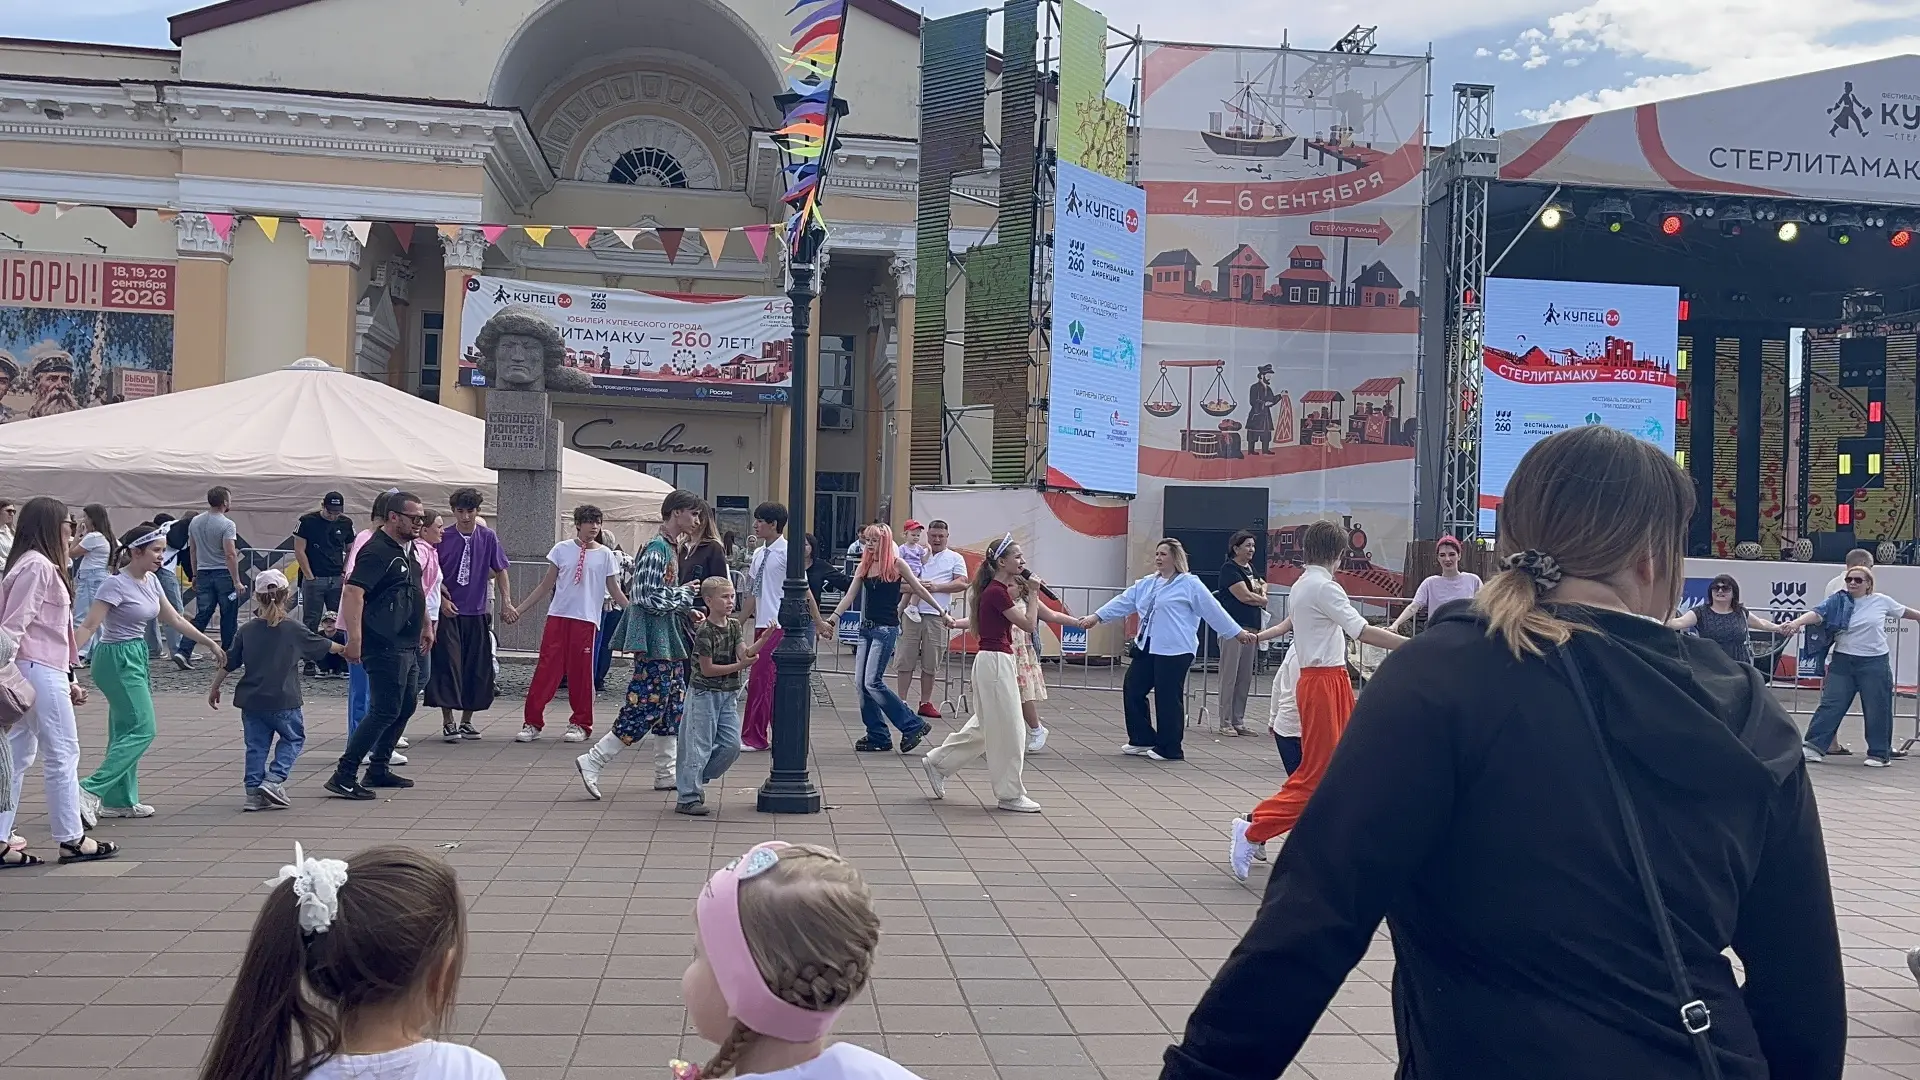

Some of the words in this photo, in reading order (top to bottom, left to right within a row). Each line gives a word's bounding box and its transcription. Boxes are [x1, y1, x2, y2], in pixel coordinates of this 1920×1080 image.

[1183, 188, 1199, 208] 4
[1238, 190, 1253, 211] 6
[1261, 171, 1385, 210] СЕНТЯБРЯ
[1086, 199, 1124, 227] КУПЕЦ
[1126, 215, 1138, 226] 2.0
[1314, 224, 1379, 234] СТЕРЛИТАМАК
[1068, 256, 1084, 272] 260
[1092, 259, 1134, 276] ФЕСТИВАЛЬНАЯ
[112, 266, 129, 279] 18,
[131, 267, 147, 279] 19,
[150, 268, 167, 279] 20
[1091, 270, 1120, 282] ДИРЕКЦИЯ
[112, 280, 167, 290] сентября
[111, 289, 167, 306] 2026
[514, 292, 556, 306] КУПЕЦ
[591, 302, 607, 310] 260
[567, 315, 604, 325] ЮБИЛЕЙ
[606, 319, 667, 329] КУПЕЧЕСКОГО
[669, 322, 703, 331] ГОРОДА
[1563, 311, 1604, 324] КУПЕЦ
[671, 331, 711, 348] 260
[718, 337, 754, 349] ЛЕТ!
[1093, 347, 1117, 362] БСК
[125, 374, 155, 384] ВЫБОРЫ
[1499, 365, 1597, 382] СТЕРЛИТАМАКУ
[1614, 369, 1636, 380] 260
[1639, 370, 1666, 383] ЛЕТ!
[1058, 426, 1096, 438] БАШПЛАСТ
[1494, 422, 1511, 432] 260
[572, 418, 712, 454] Салават
